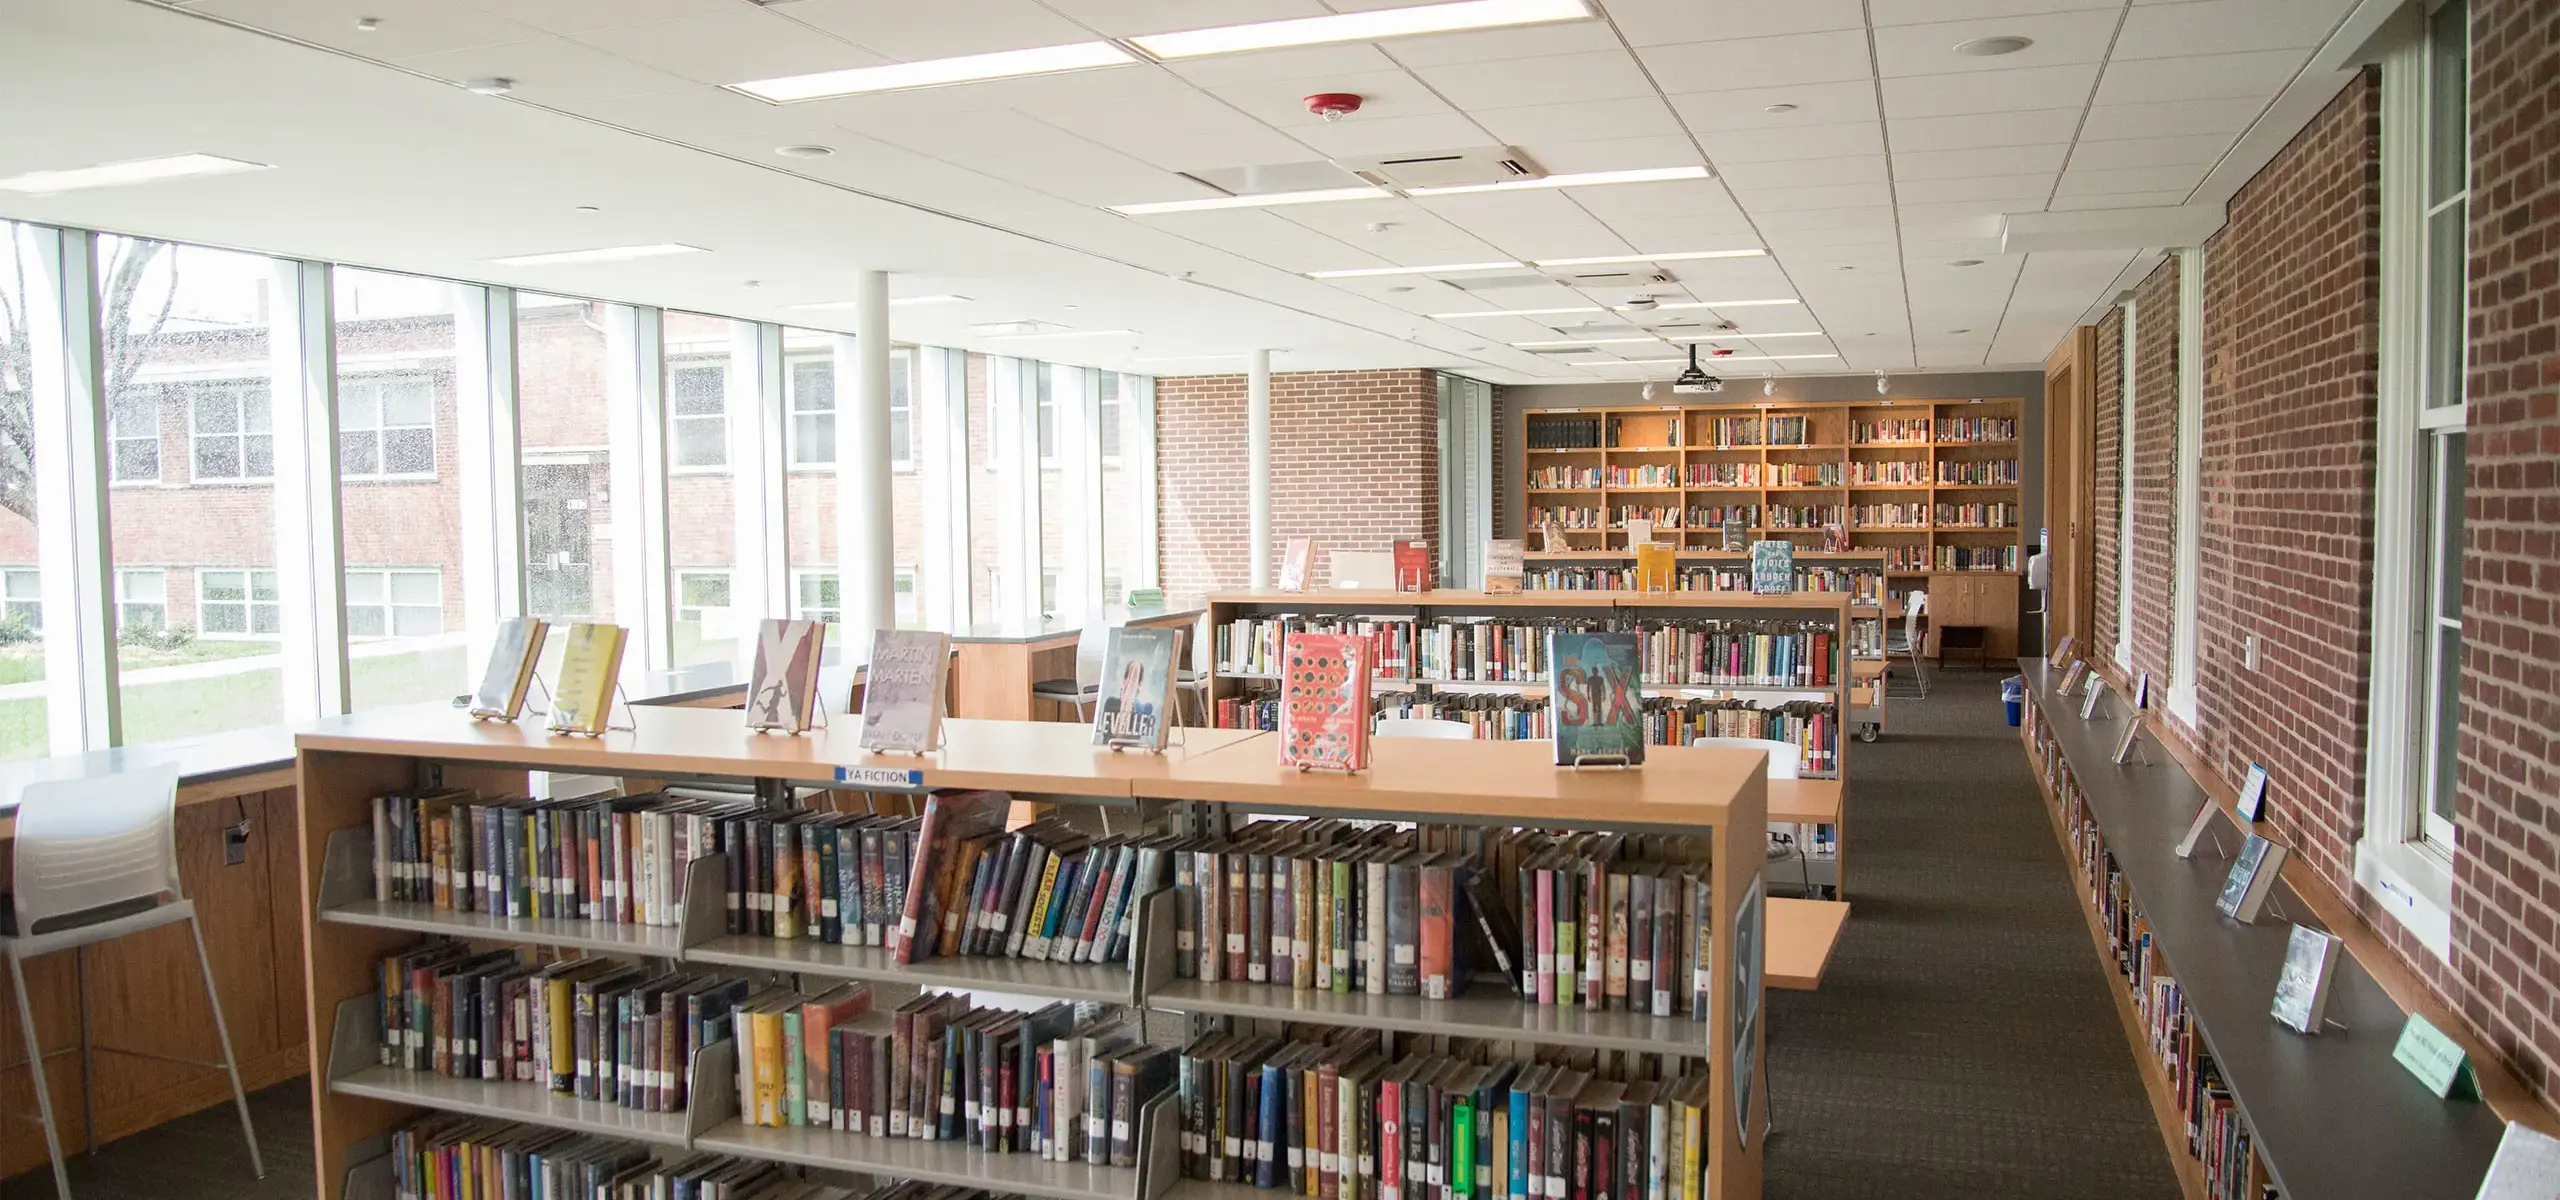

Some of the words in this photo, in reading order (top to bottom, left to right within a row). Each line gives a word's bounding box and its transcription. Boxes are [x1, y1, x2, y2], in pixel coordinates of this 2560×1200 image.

[875, 645, 932, 664] MARTIN
[871, 668, 932, 685] MARTEN
[848, 768, 862, 780] YA
[864, 770, 907, 783] FICTION
